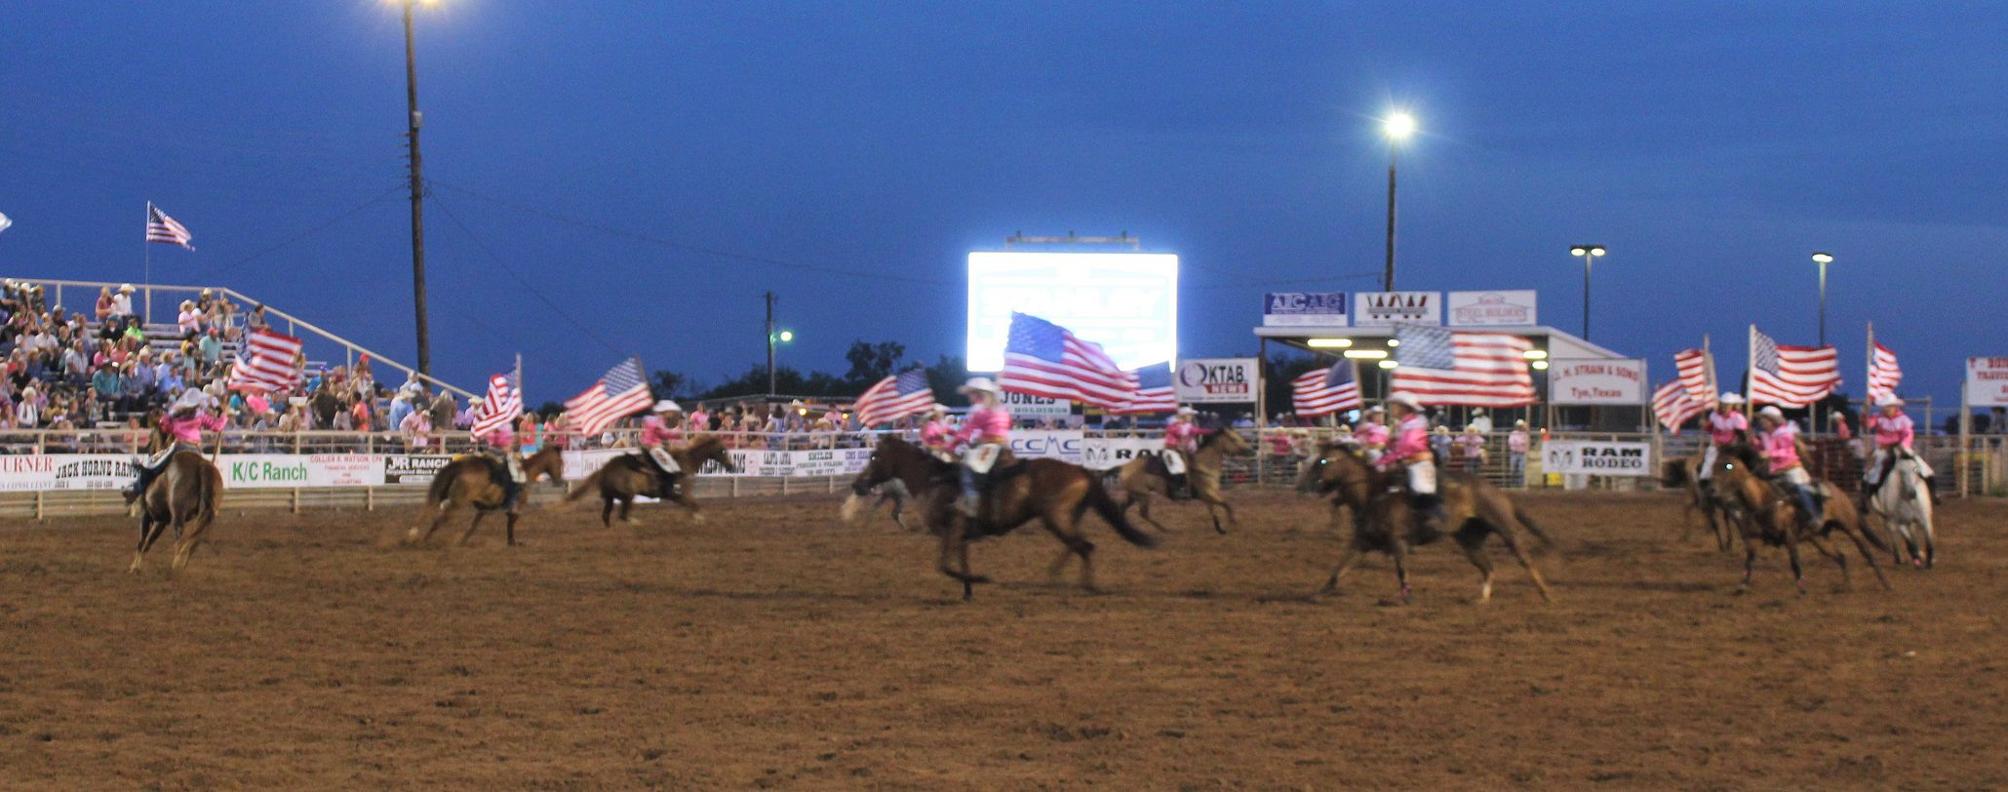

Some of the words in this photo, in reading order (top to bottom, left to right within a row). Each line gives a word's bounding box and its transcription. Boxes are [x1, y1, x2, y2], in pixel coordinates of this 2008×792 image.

[1209, 366, 1244, 383] KTAB
[1592, 387, 1622, 398] Texas
[1582, 447, 1642, 457] RAM
[412, 458, 449, 469] RANCH
[1582, 458, 1642, 468] RODEO
[56, 462, 79, 479] JACK
[81, 460, 112, 477] HORNE
[232, 461, 258, 482] K/C
[263, 461, 307, 481] Ranch
